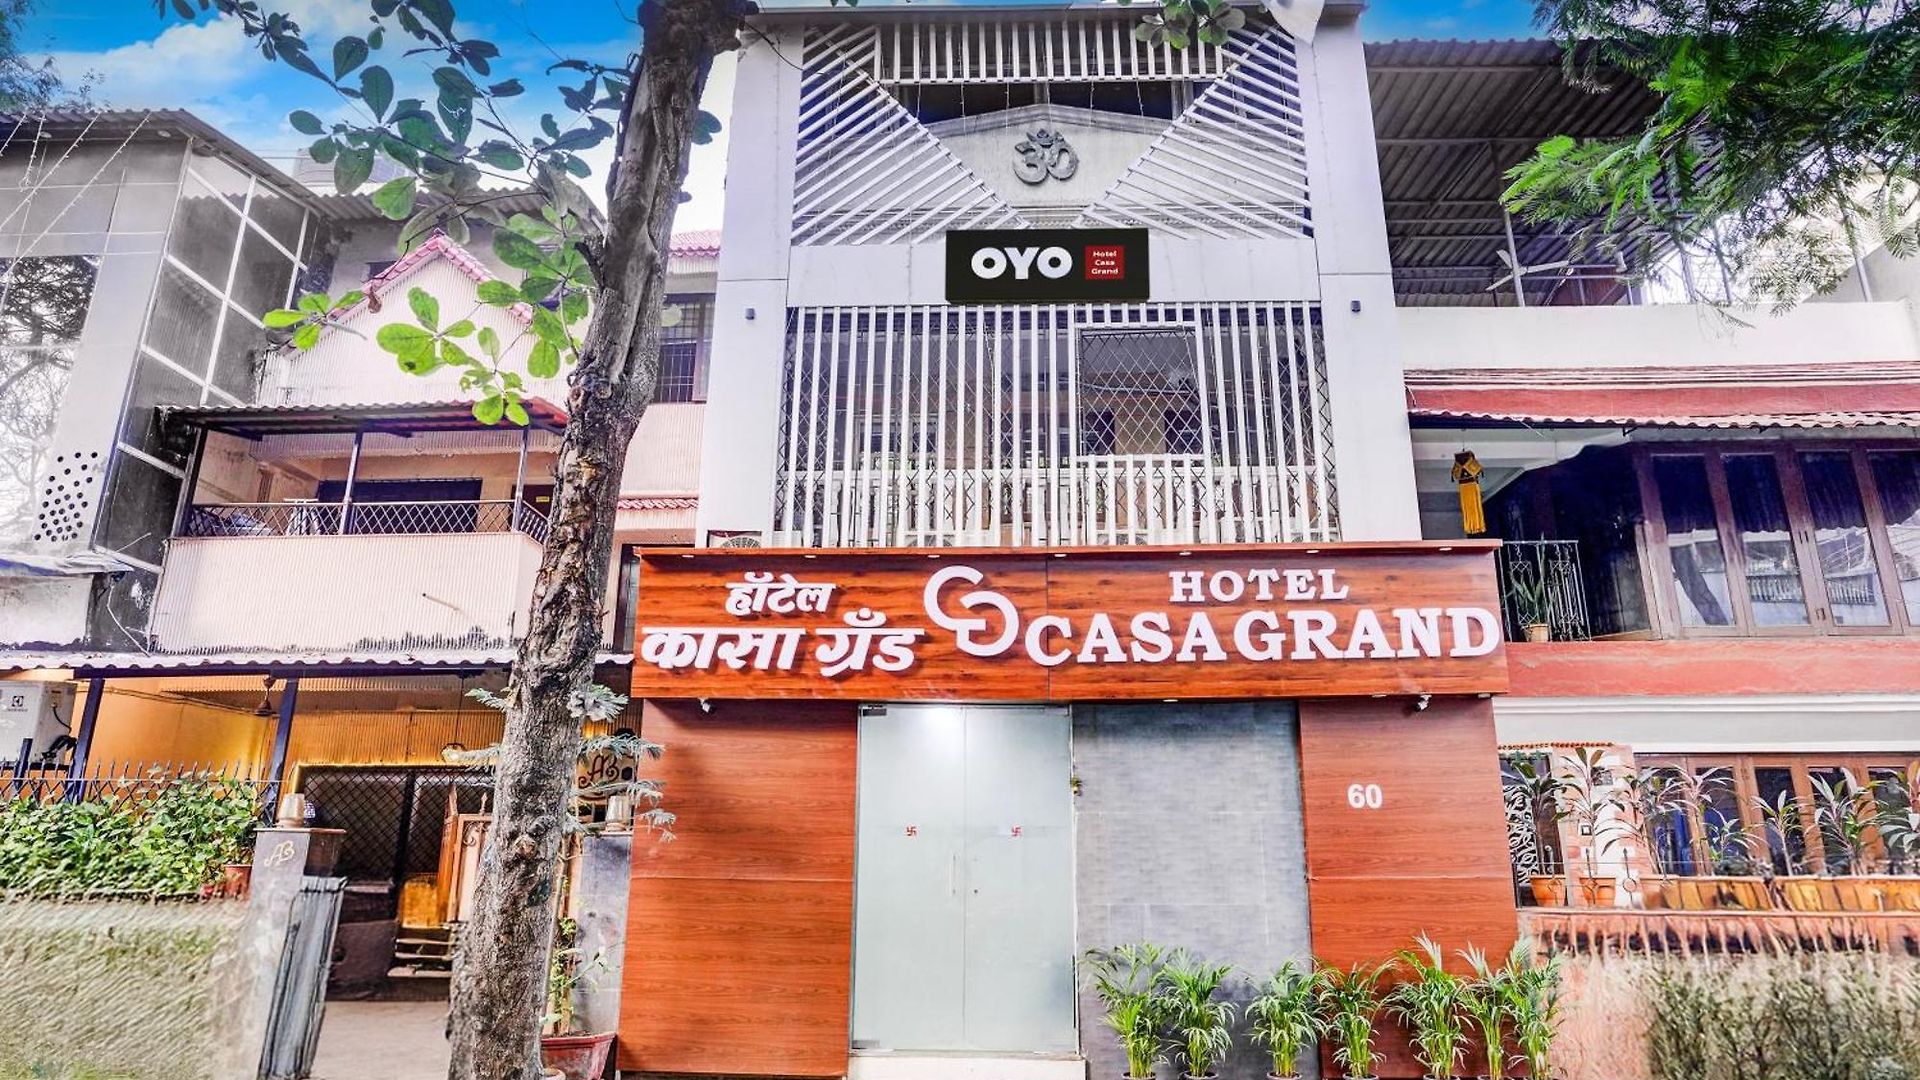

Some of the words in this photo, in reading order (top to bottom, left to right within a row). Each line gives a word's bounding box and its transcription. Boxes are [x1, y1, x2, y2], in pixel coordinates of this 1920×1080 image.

[971, 246, 1073, 280] OYO
[1091, 267, 1119, 275] Grand
[725, 571, 836, 615] हॉटेल
[1169, 568, 1349, 602] HOTEL
[641, 627, 806, 670] कासा
[1024, 607, 1502, 666] CASAGRAND
[1347, 783, 1383, 809] 60
